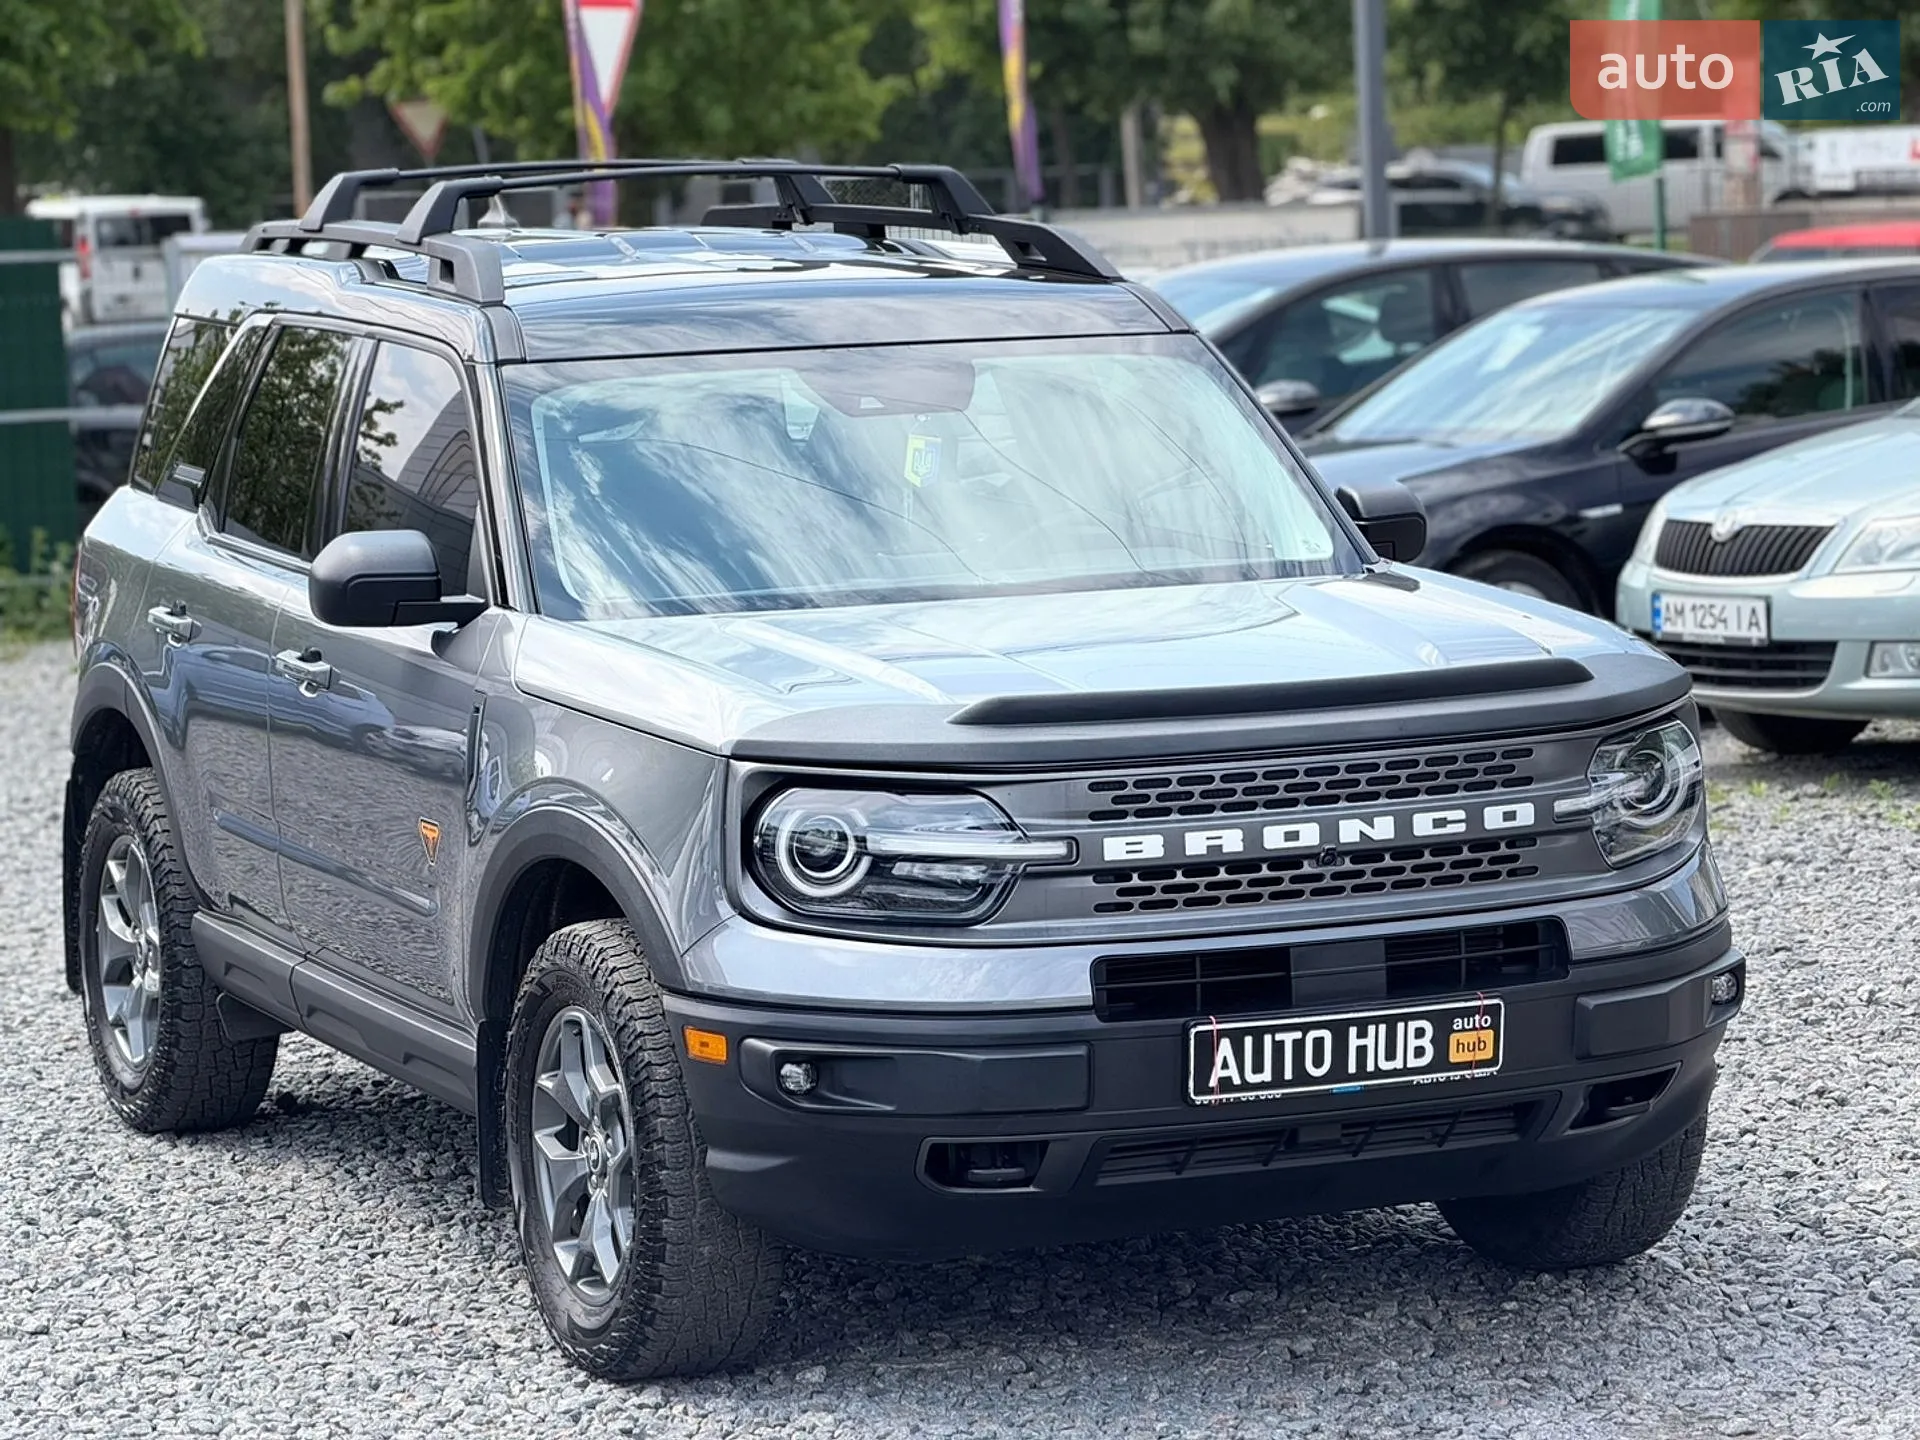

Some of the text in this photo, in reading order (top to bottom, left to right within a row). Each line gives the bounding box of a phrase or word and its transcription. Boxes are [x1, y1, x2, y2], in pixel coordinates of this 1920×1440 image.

[1663, 602, 1762, 633] AM 1254 IA
[1102, 801, 1535, 862] BRONCO
[1452, 1014, 1492, 1031] auto
[1208, 1019, 1435, 1088] AUTO HUB
[1456, 1035, 1487, 1054] hub
